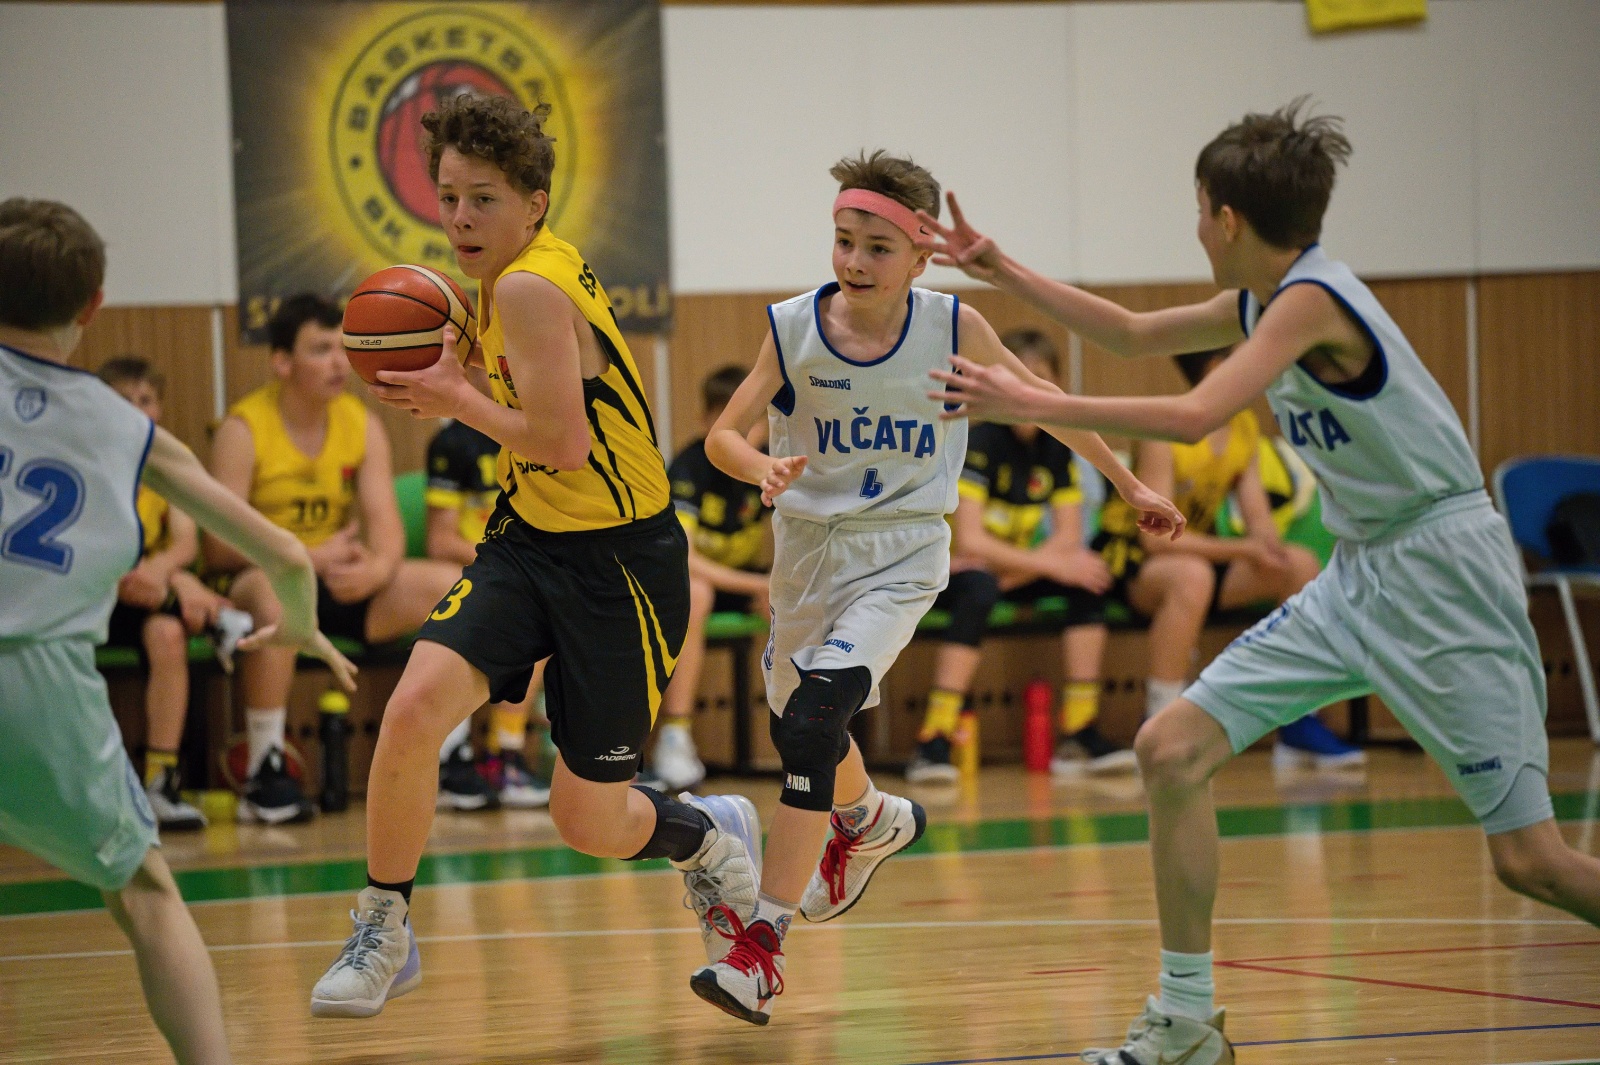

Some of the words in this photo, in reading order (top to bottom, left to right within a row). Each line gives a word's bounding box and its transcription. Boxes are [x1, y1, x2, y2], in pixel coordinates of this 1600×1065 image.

[348, 27, 545, 131] BASKETBA
[808, 375, 851, 391] SPALDING
[814, 406, 936, 459] VLČATA
[859, 468, 884, 500] 4
[0, 445, 87, 576] 2
[425, 578, 473, 622] 3
[792, 774, 811, 792] NBA
